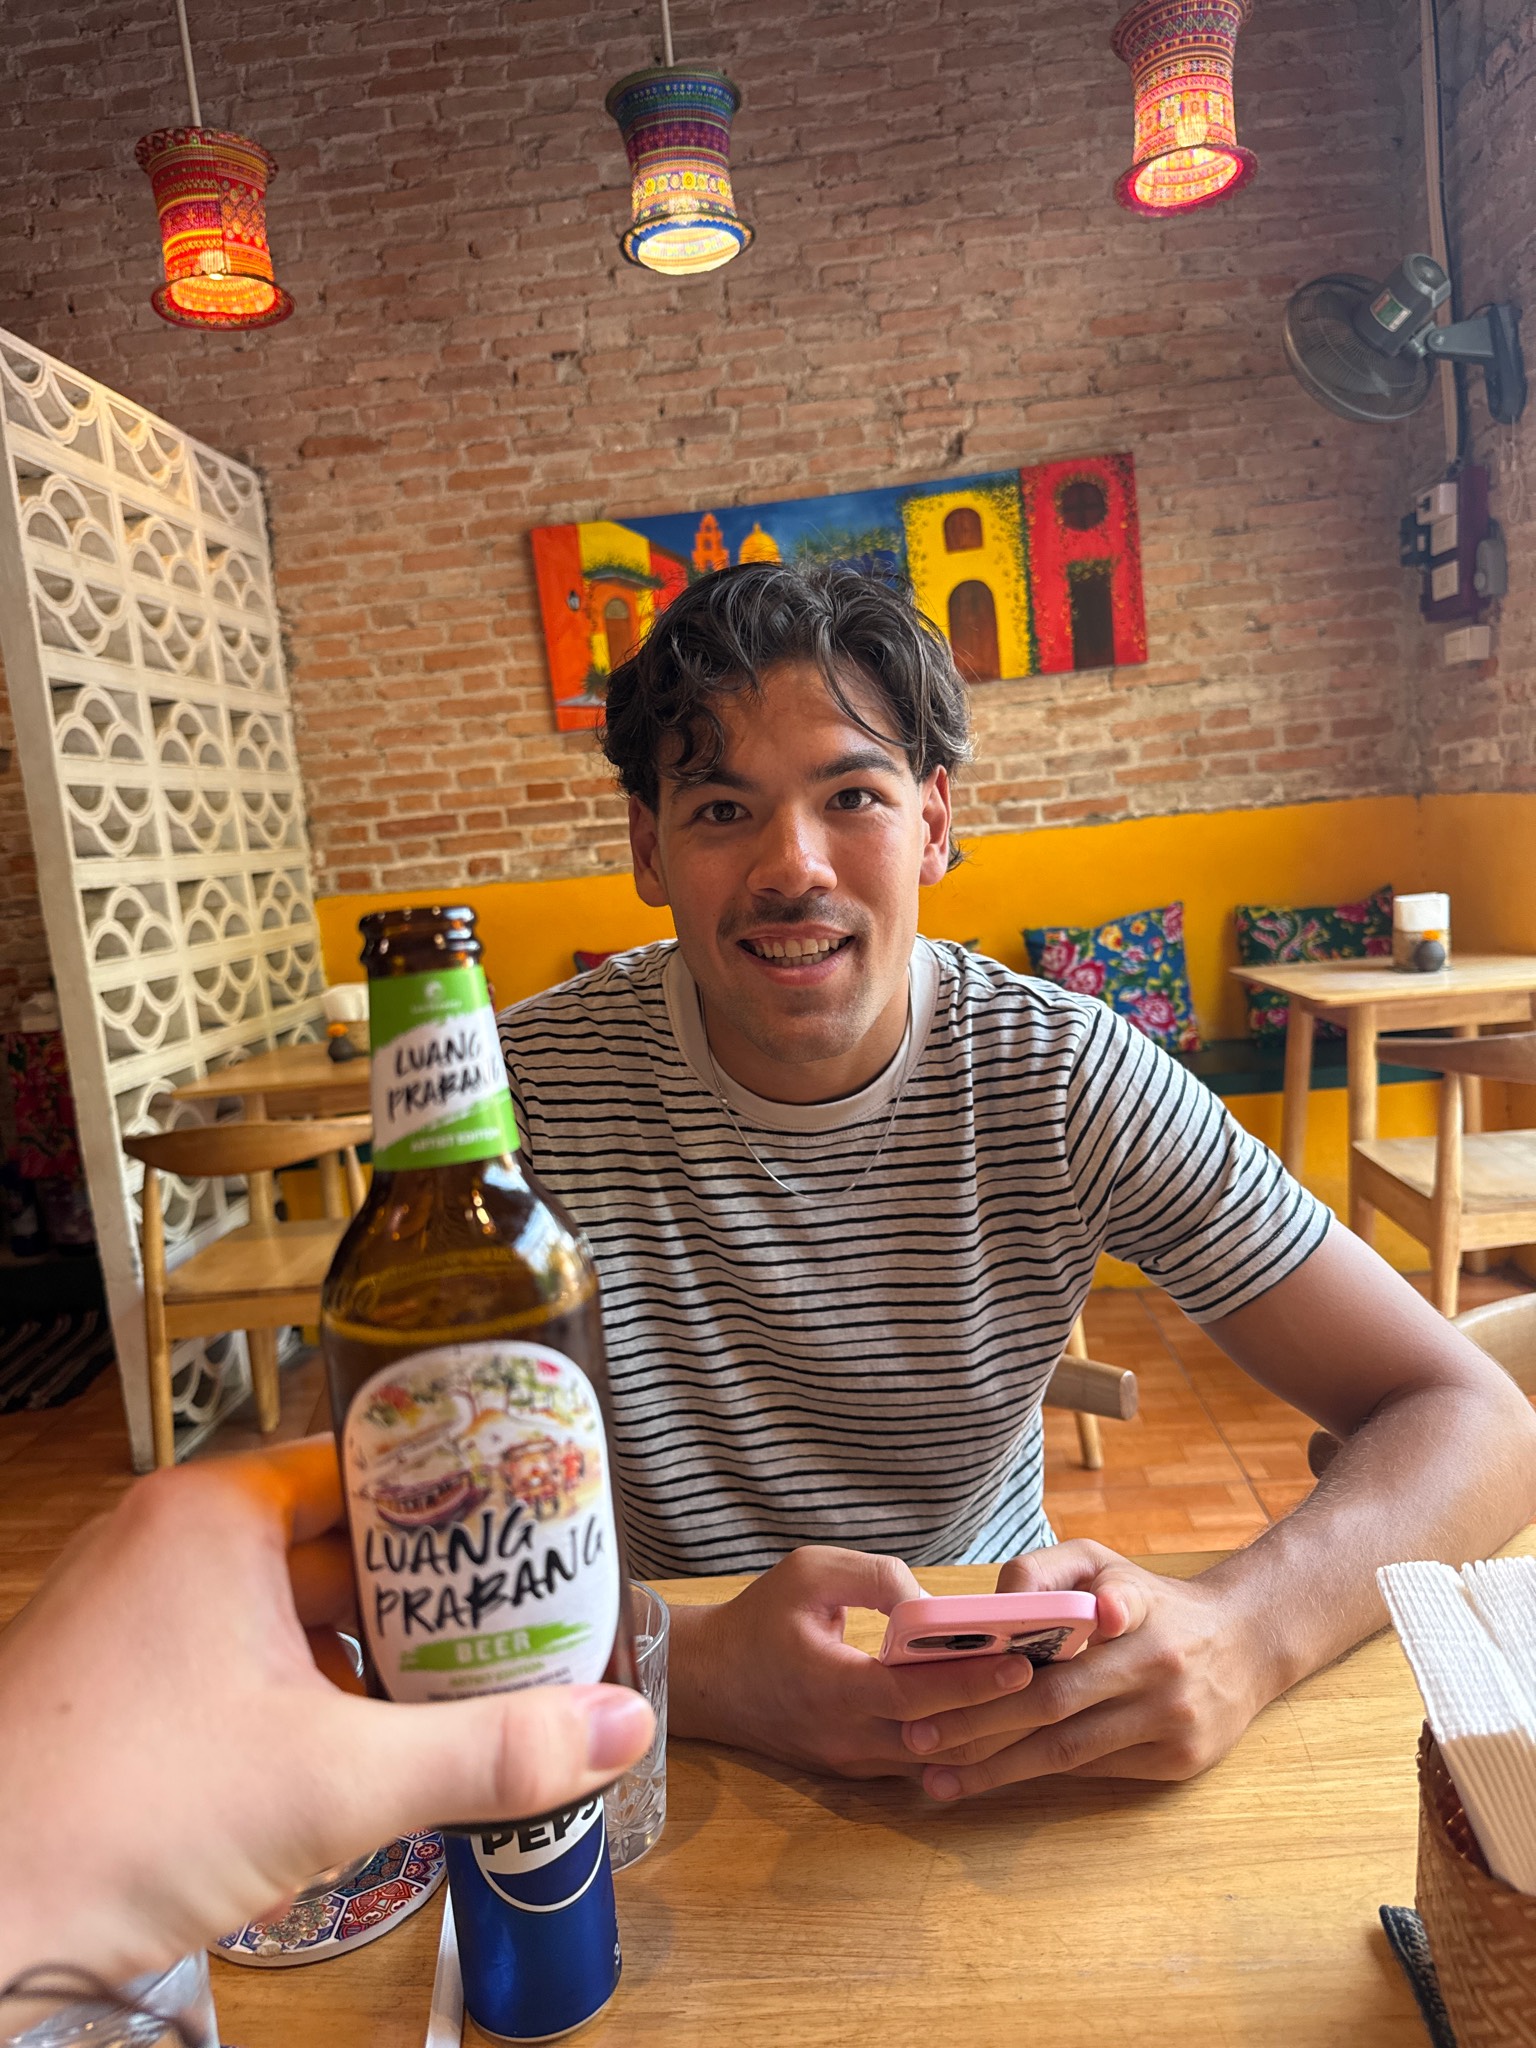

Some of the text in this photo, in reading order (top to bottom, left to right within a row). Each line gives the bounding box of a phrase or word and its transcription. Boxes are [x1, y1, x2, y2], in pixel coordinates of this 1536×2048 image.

[394, 1030, 481, 1077] LUANG
[365, 1505, 536, 1574] LUANG
[376, 1514, 604, 1637] PRABANG
[454, 1629, 531, 1663] BEER
[481, 1796, 602, 1856] PEPS
